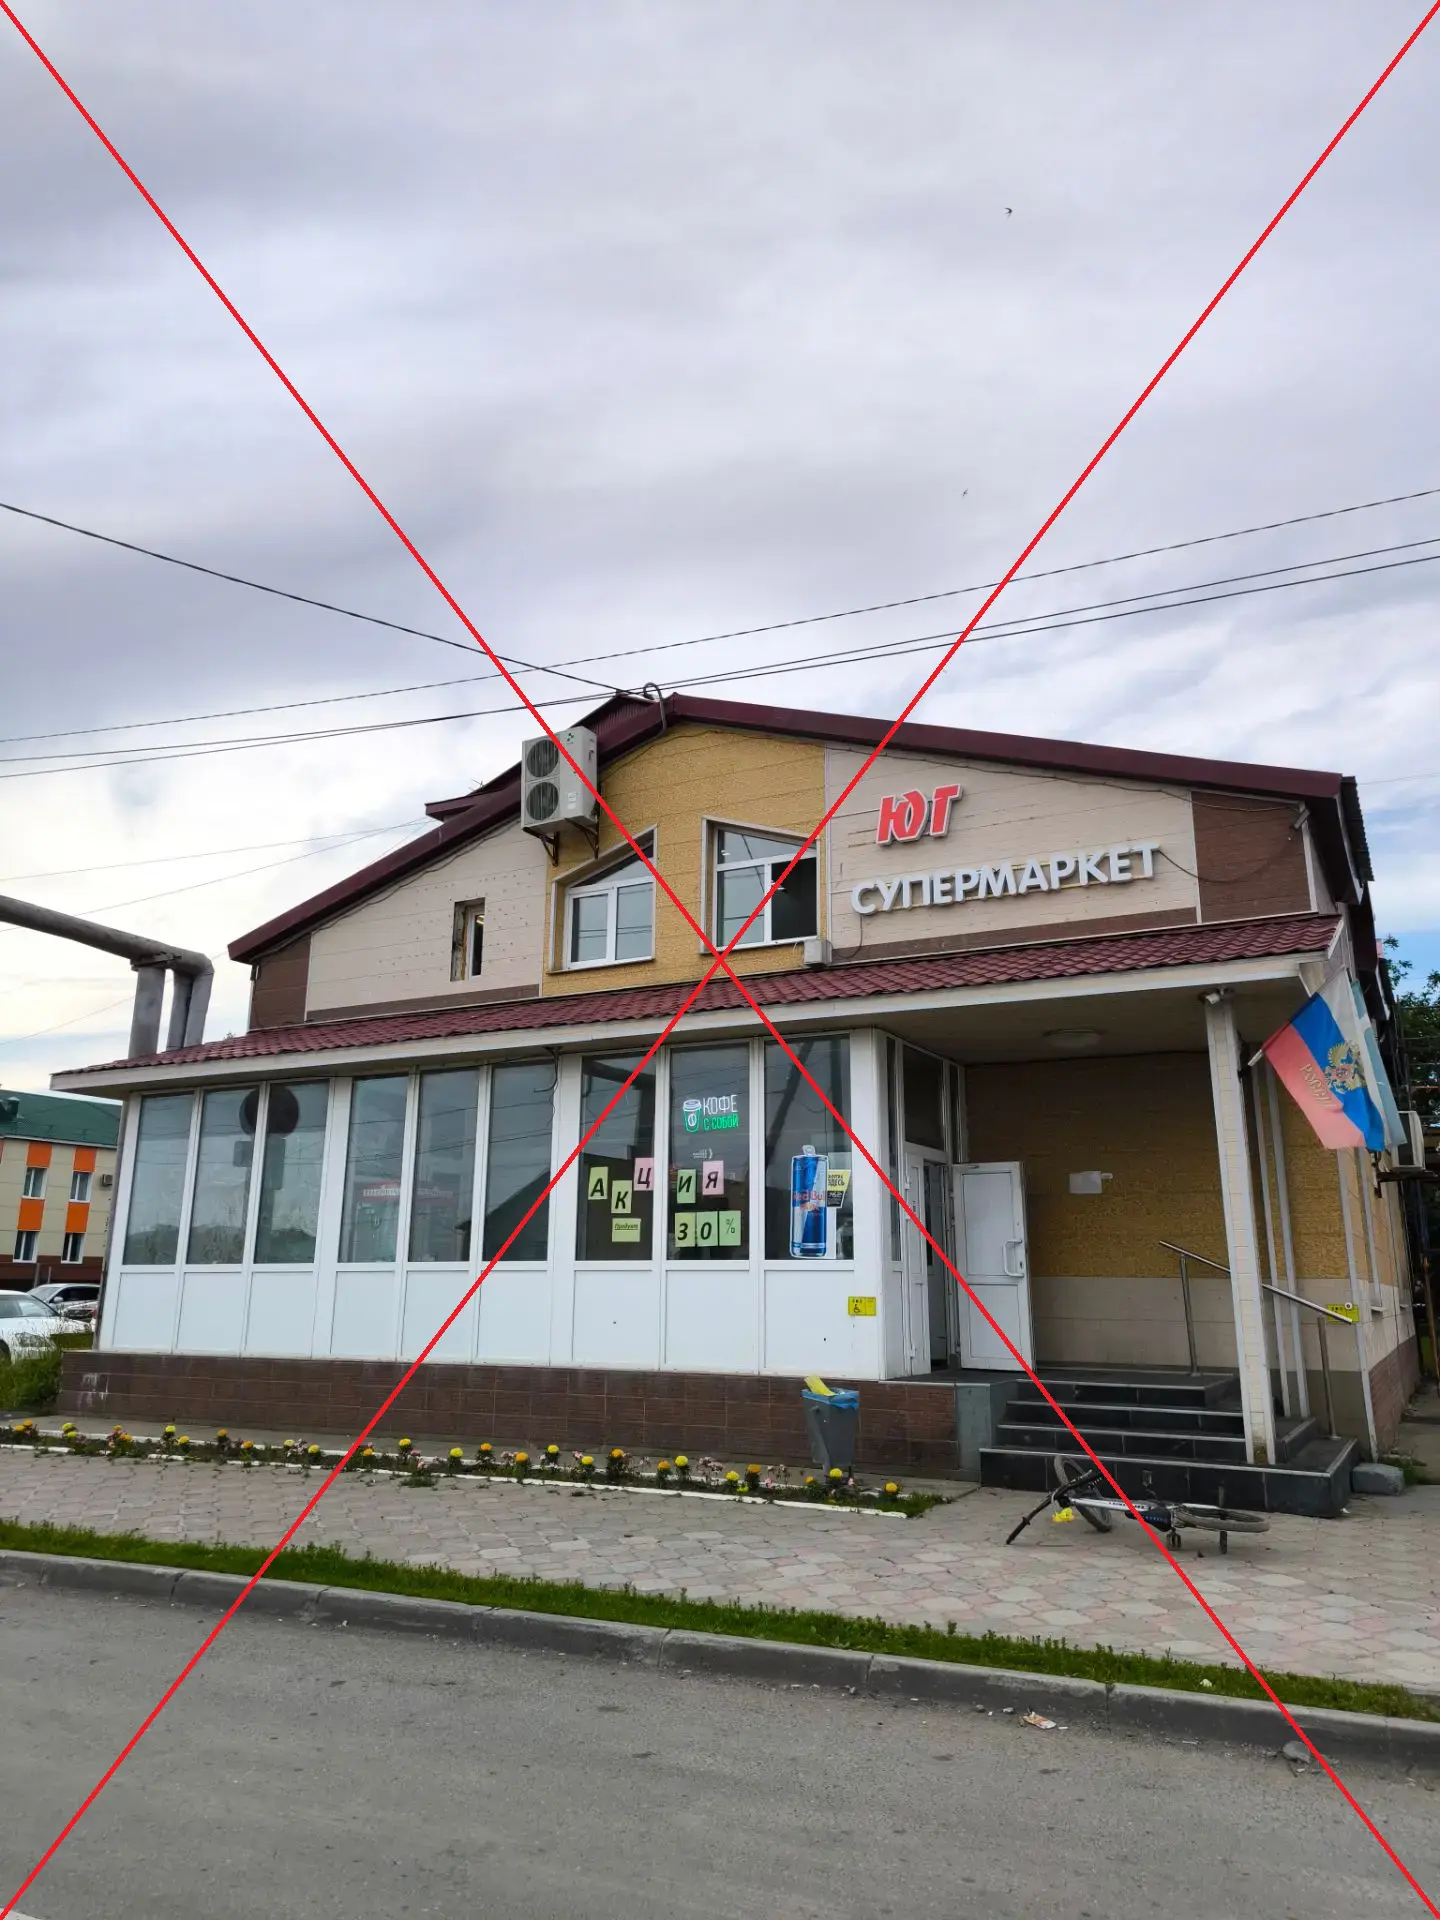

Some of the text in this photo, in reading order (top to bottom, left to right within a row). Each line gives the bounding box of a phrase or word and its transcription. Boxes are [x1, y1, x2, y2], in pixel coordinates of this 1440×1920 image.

[876, 784, 962, 846] ЮГ
[851, 841, 1161, 915] СУПЕРМАРКЕТ
[703, 1094, 739, 1116] КОФЕ
[1299, 1063, 1338, 1108] РОССИ
